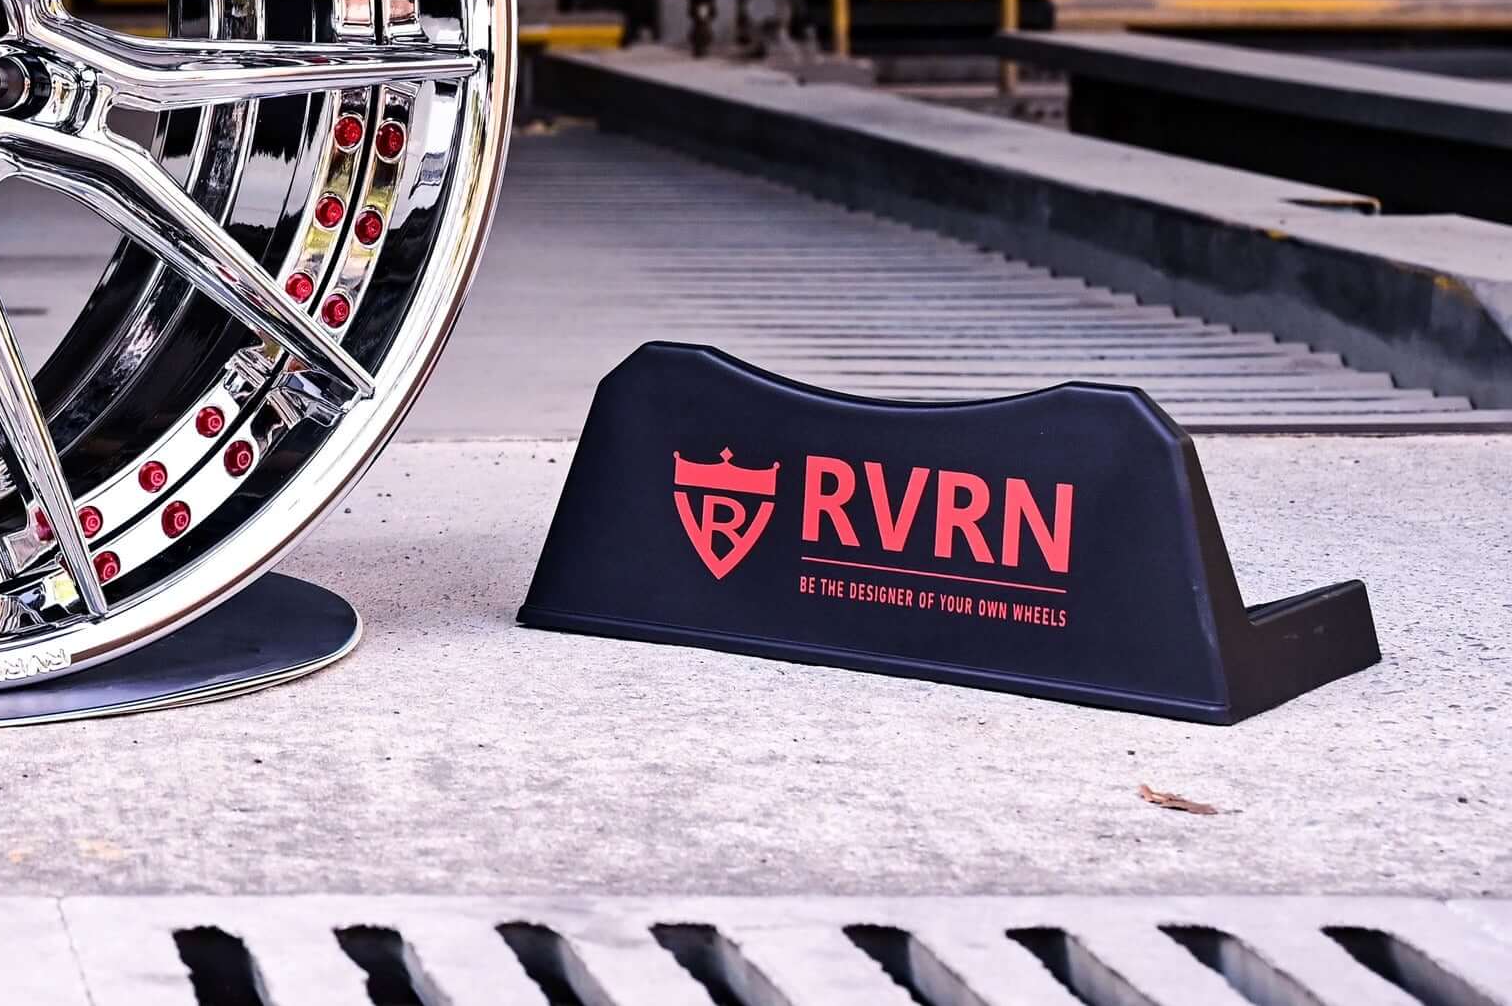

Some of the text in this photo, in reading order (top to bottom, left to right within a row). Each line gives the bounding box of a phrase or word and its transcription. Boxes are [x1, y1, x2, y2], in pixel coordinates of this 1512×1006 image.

[801, 455, 1074, 574] RVRN
[799, 576, 1067, 628] BE THE DESIGNER OF YOUR OWN WHEELS
